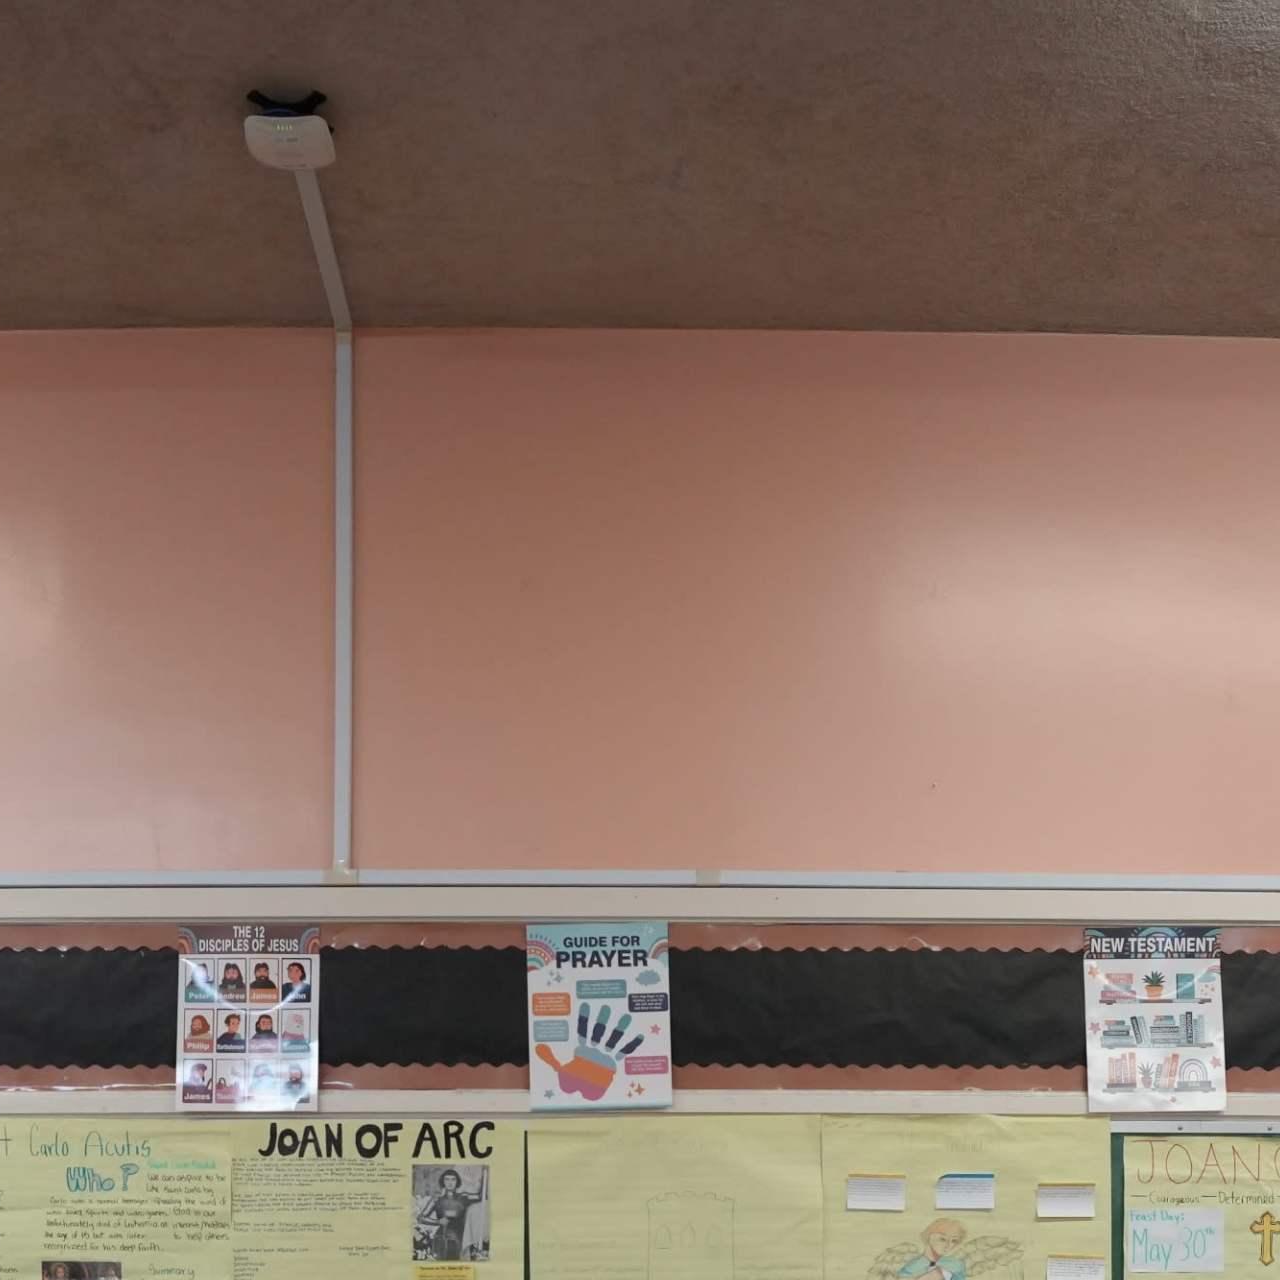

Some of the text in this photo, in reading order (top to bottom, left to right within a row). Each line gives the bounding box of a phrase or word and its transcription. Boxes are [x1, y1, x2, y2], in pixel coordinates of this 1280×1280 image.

[233, 926, 265, 938] THE 12
[199, 939, 299, 952] DISCIPLES OF JESUS
[563, 935, 640, 948] GUIDE FOR
[1090, 937, 1215, 952] NEW TESTAMENT
[556, 950, 648, 969] PRAYER
[30, 1124, 69, 1157] Carlo
[84, 1130, 151, 1157] Acutis
[258, 1120, 495, 1159] JOAN OF ARC
[1131, 1139, 1262, 1185] JOAN
[1149, 1193, 1200, 1205] Courageous
[1218, 1191, 1275, 1205] Determined
[1129, 1210, 1185, 1223] Feast Day:
[1132, 1227, 1216, 1270] May 30th
[148, 1264, 195, 1280] Summary
